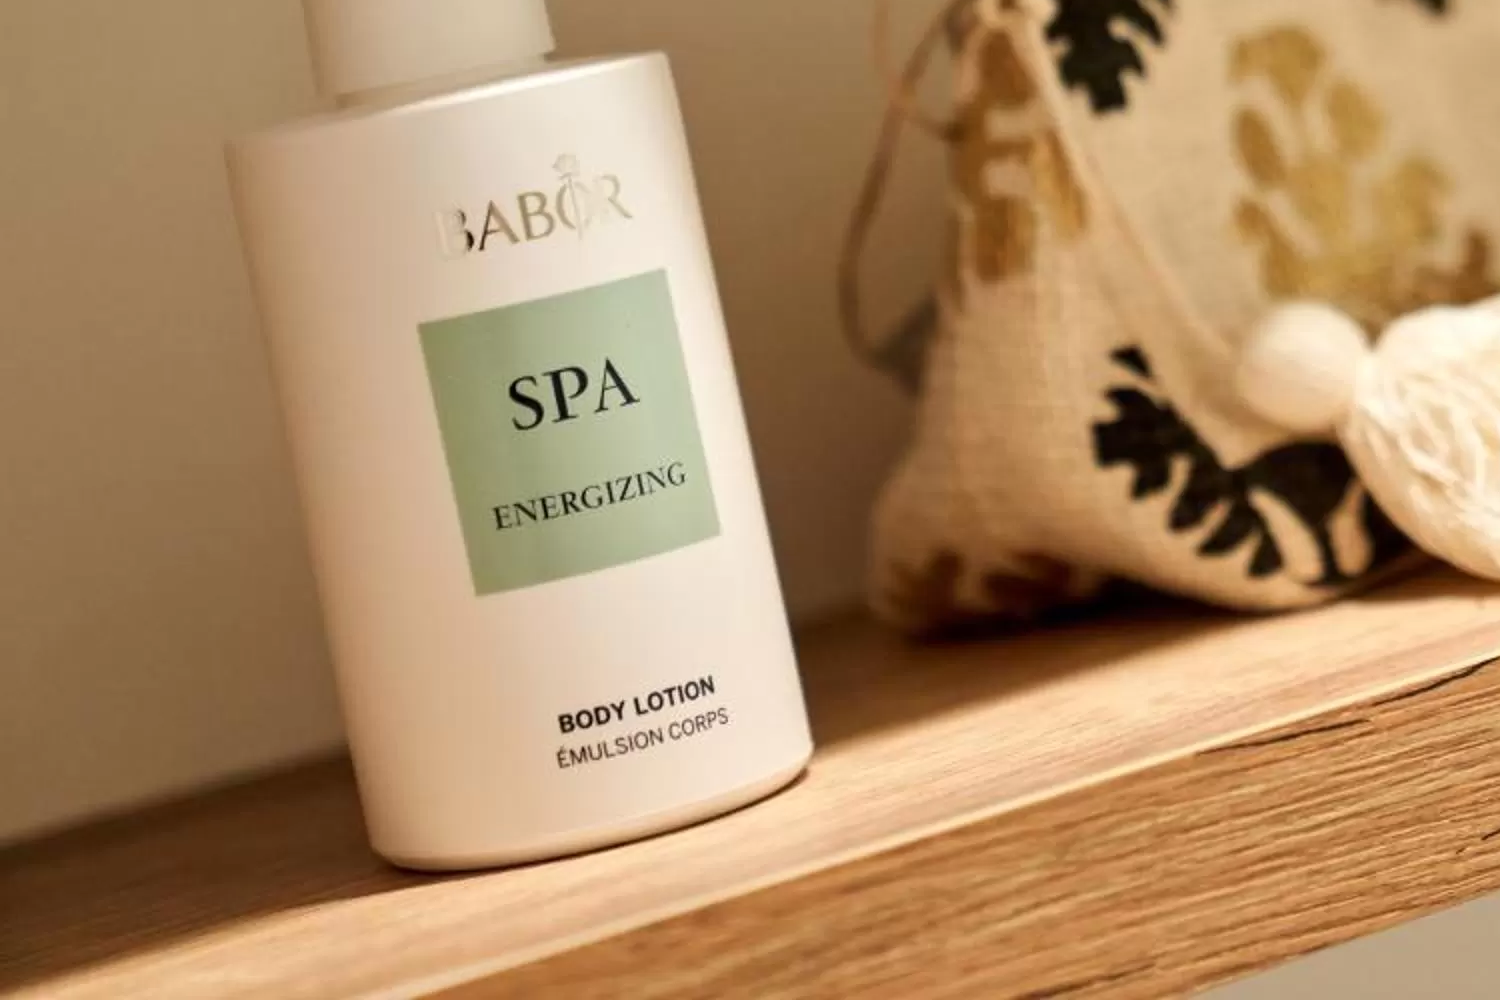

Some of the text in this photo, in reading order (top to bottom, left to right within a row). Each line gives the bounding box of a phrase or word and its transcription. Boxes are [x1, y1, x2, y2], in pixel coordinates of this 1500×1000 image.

[438, 165, 633, 260] BABOR
[508, 357, 641, 431] SPA
[492, 461, 688, 530] ENERGIZING
[556, 707, 730, 769] ÉMULSION CORPS
[558, 675, 716, 735] BODY LOTION
